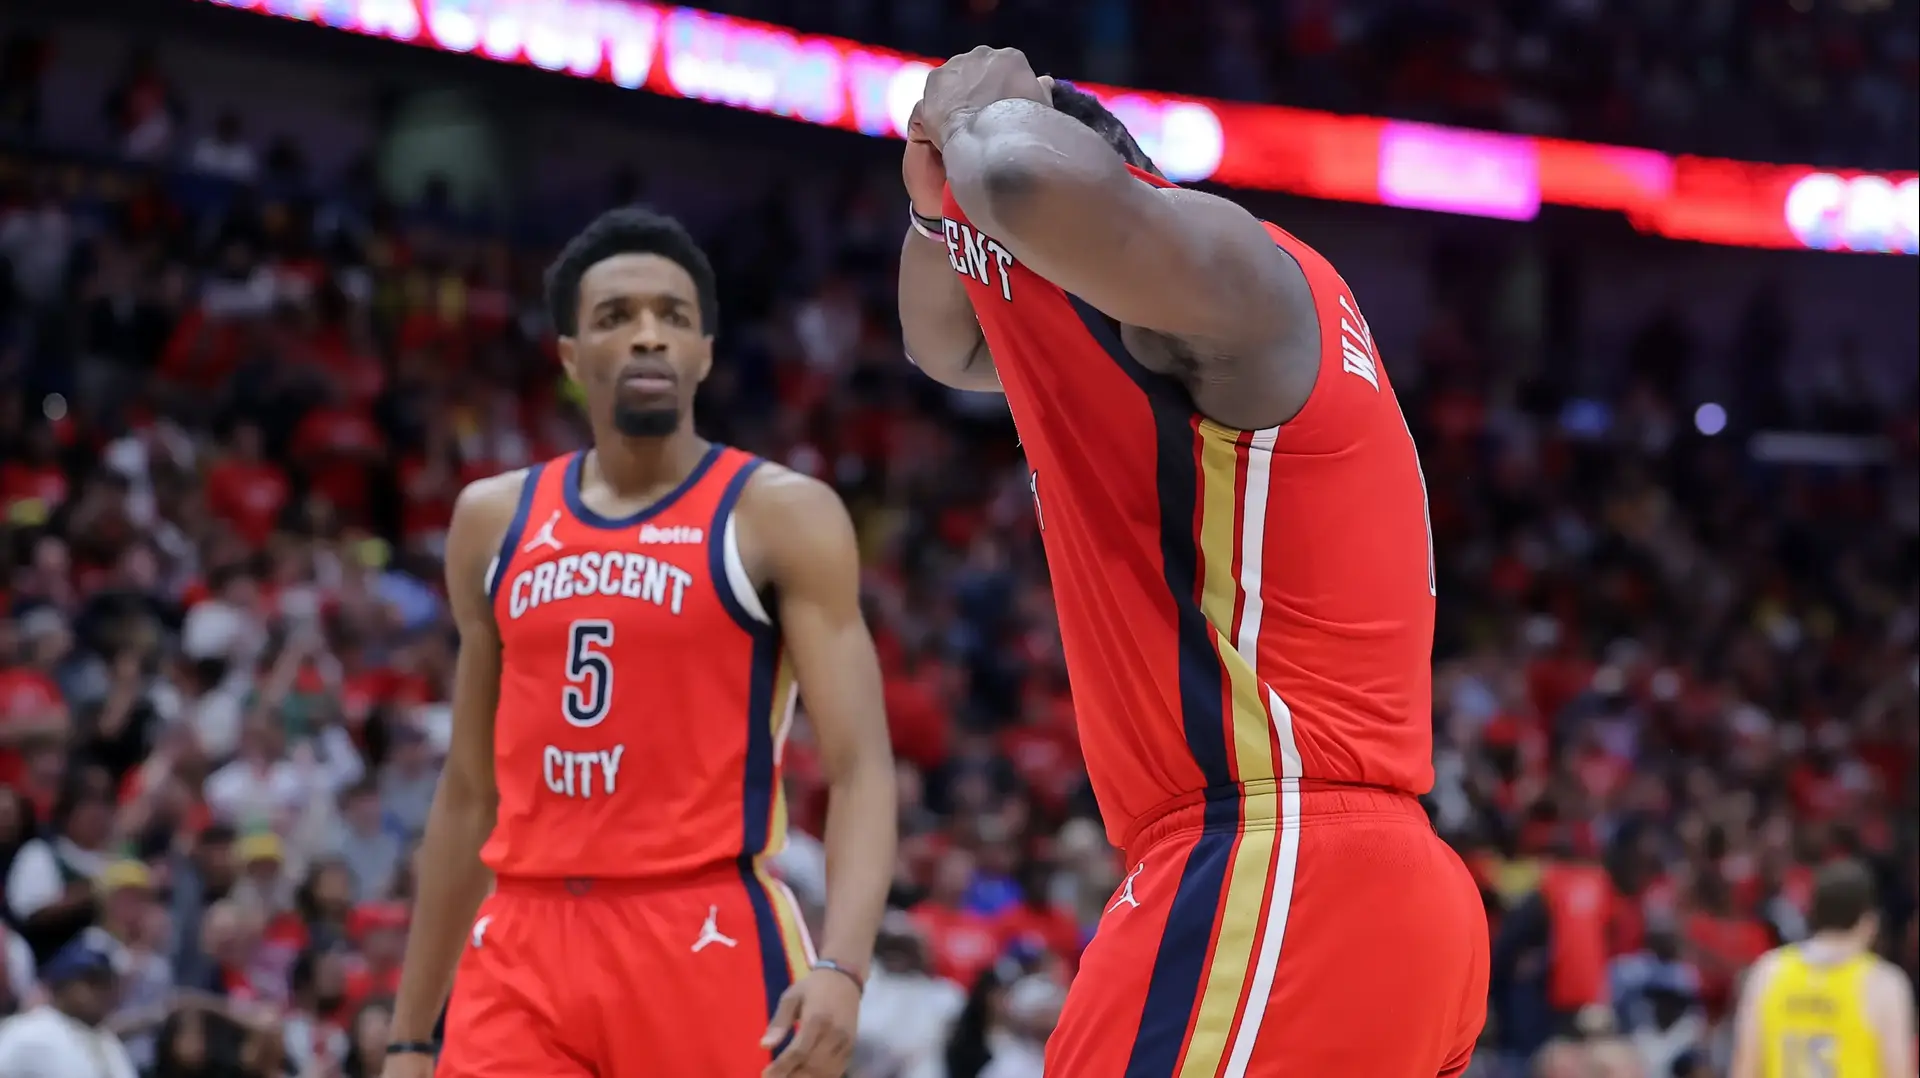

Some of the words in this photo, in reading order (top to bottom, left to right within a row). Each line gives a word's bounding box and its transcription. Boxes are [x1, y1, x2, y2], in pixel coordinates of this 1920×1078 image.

[942, 215, 1013, 302] ENT
[509, 551, 693, 619] CRESCENT
[562, 618, 614, 728] 5
[543, 744, 625, 799] CITY
